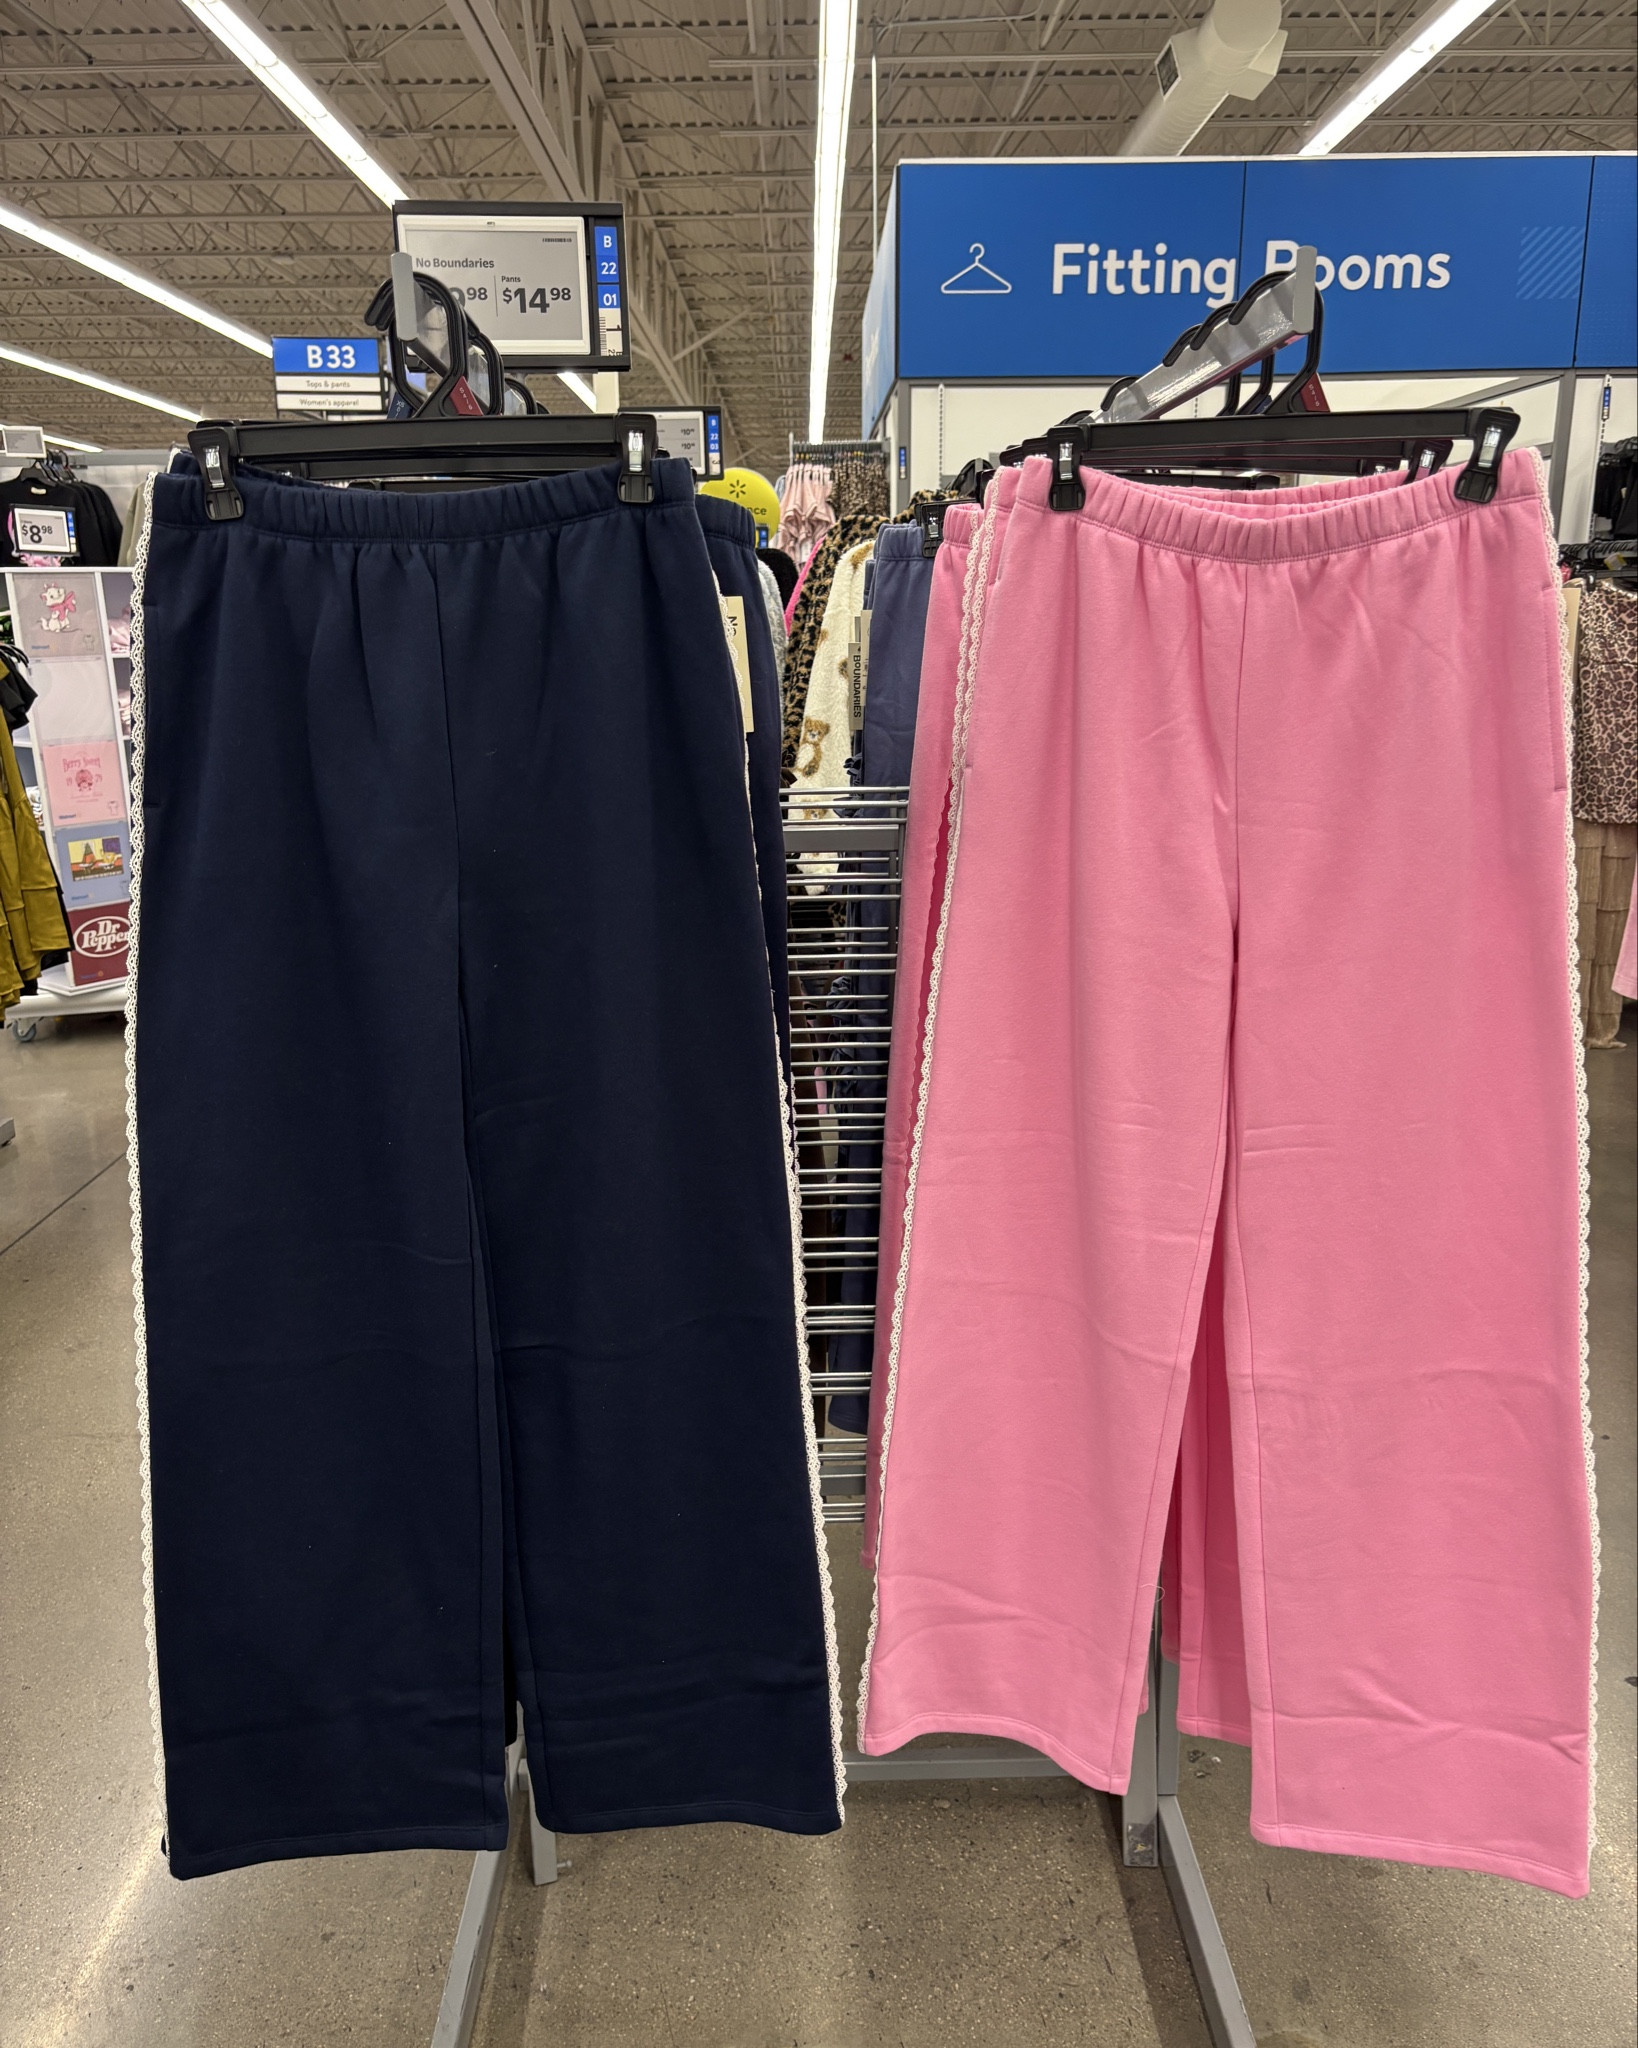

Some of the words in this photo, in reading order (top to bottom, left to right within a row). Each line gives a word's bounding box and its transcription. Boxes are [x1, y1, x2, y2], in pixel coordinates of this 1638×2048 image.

[603, 235, 612, 248] B
[416, 258, 431, 268] No
[433, 258, 495, 268] Boundaries
[601, 261, 617, 275] 22
[501, 275, 521, 283] Pants
[1051, 242, 1236, 309] Fitting
[603, 293, 617, 306] 01
[306, 380, 322, 389] Tops
[323, 380, 329, 388] &
[331, 381, 351, 389] pants
[299, 398, 331, 406] Women's
[333, 398, 360, 407] apparel
[853, 654, 862, 719] BOUNDARIES
[97, 919, 121, 936] Dr
